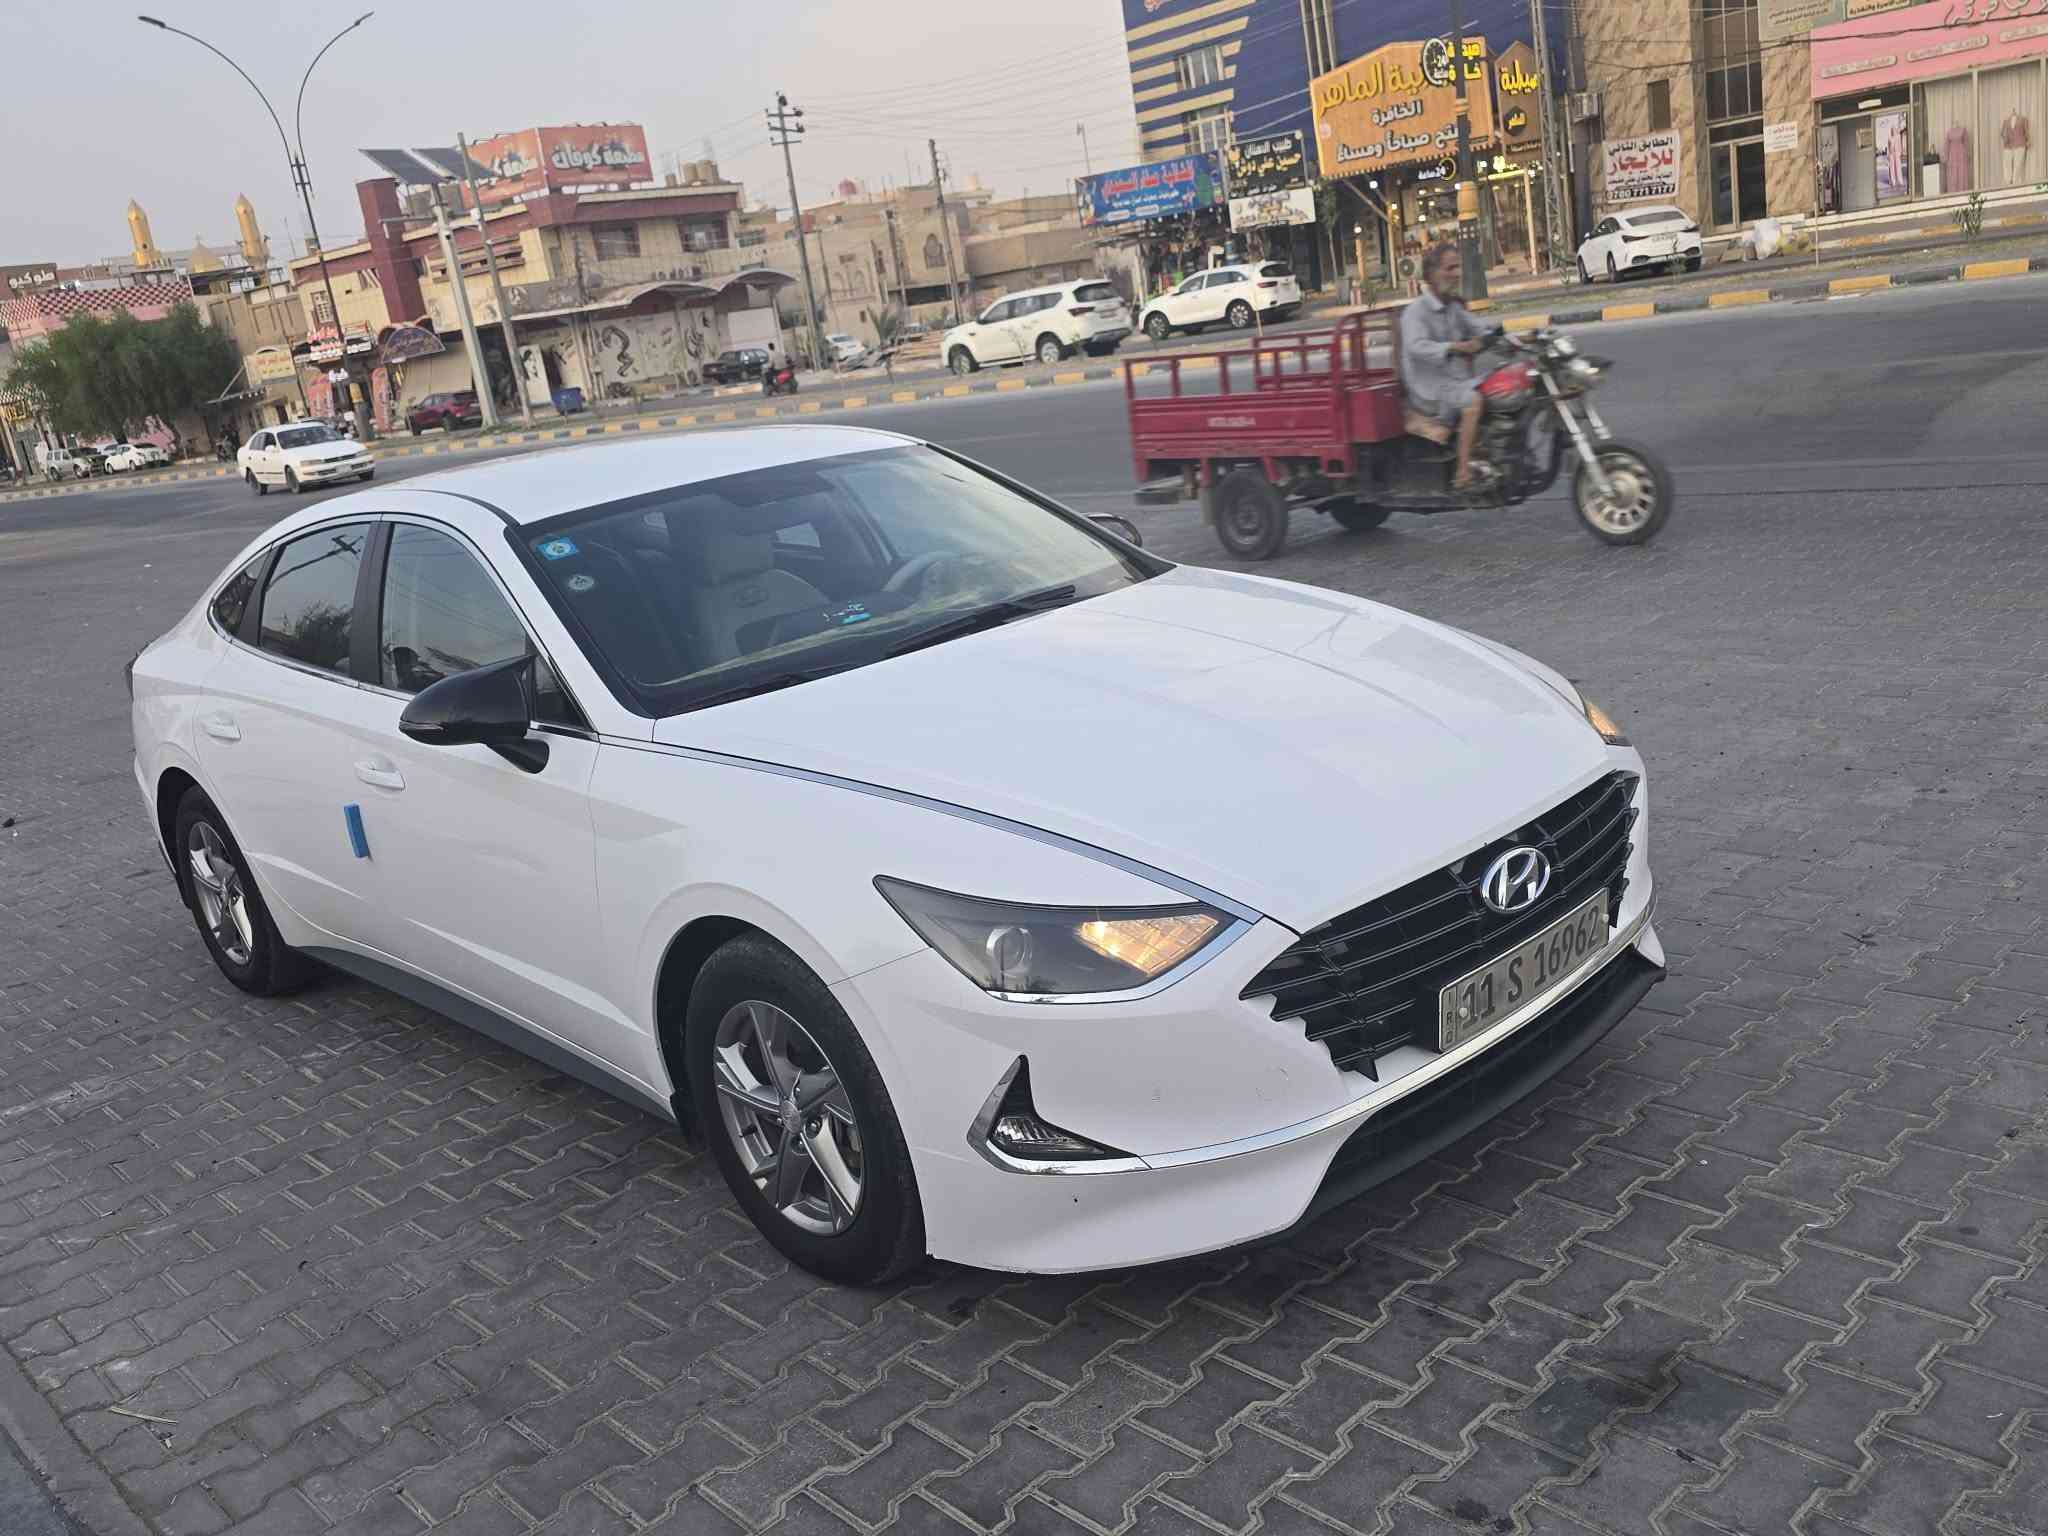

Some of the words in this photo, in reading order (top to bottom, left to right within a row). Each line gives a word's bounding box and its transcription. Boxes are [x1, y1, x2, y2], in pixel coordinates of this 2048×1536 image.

[1461, 973, 1496, 1029] 11
[1507, 956, 1523, 1003] S
[1534, 905, 1600, 988] 16962
